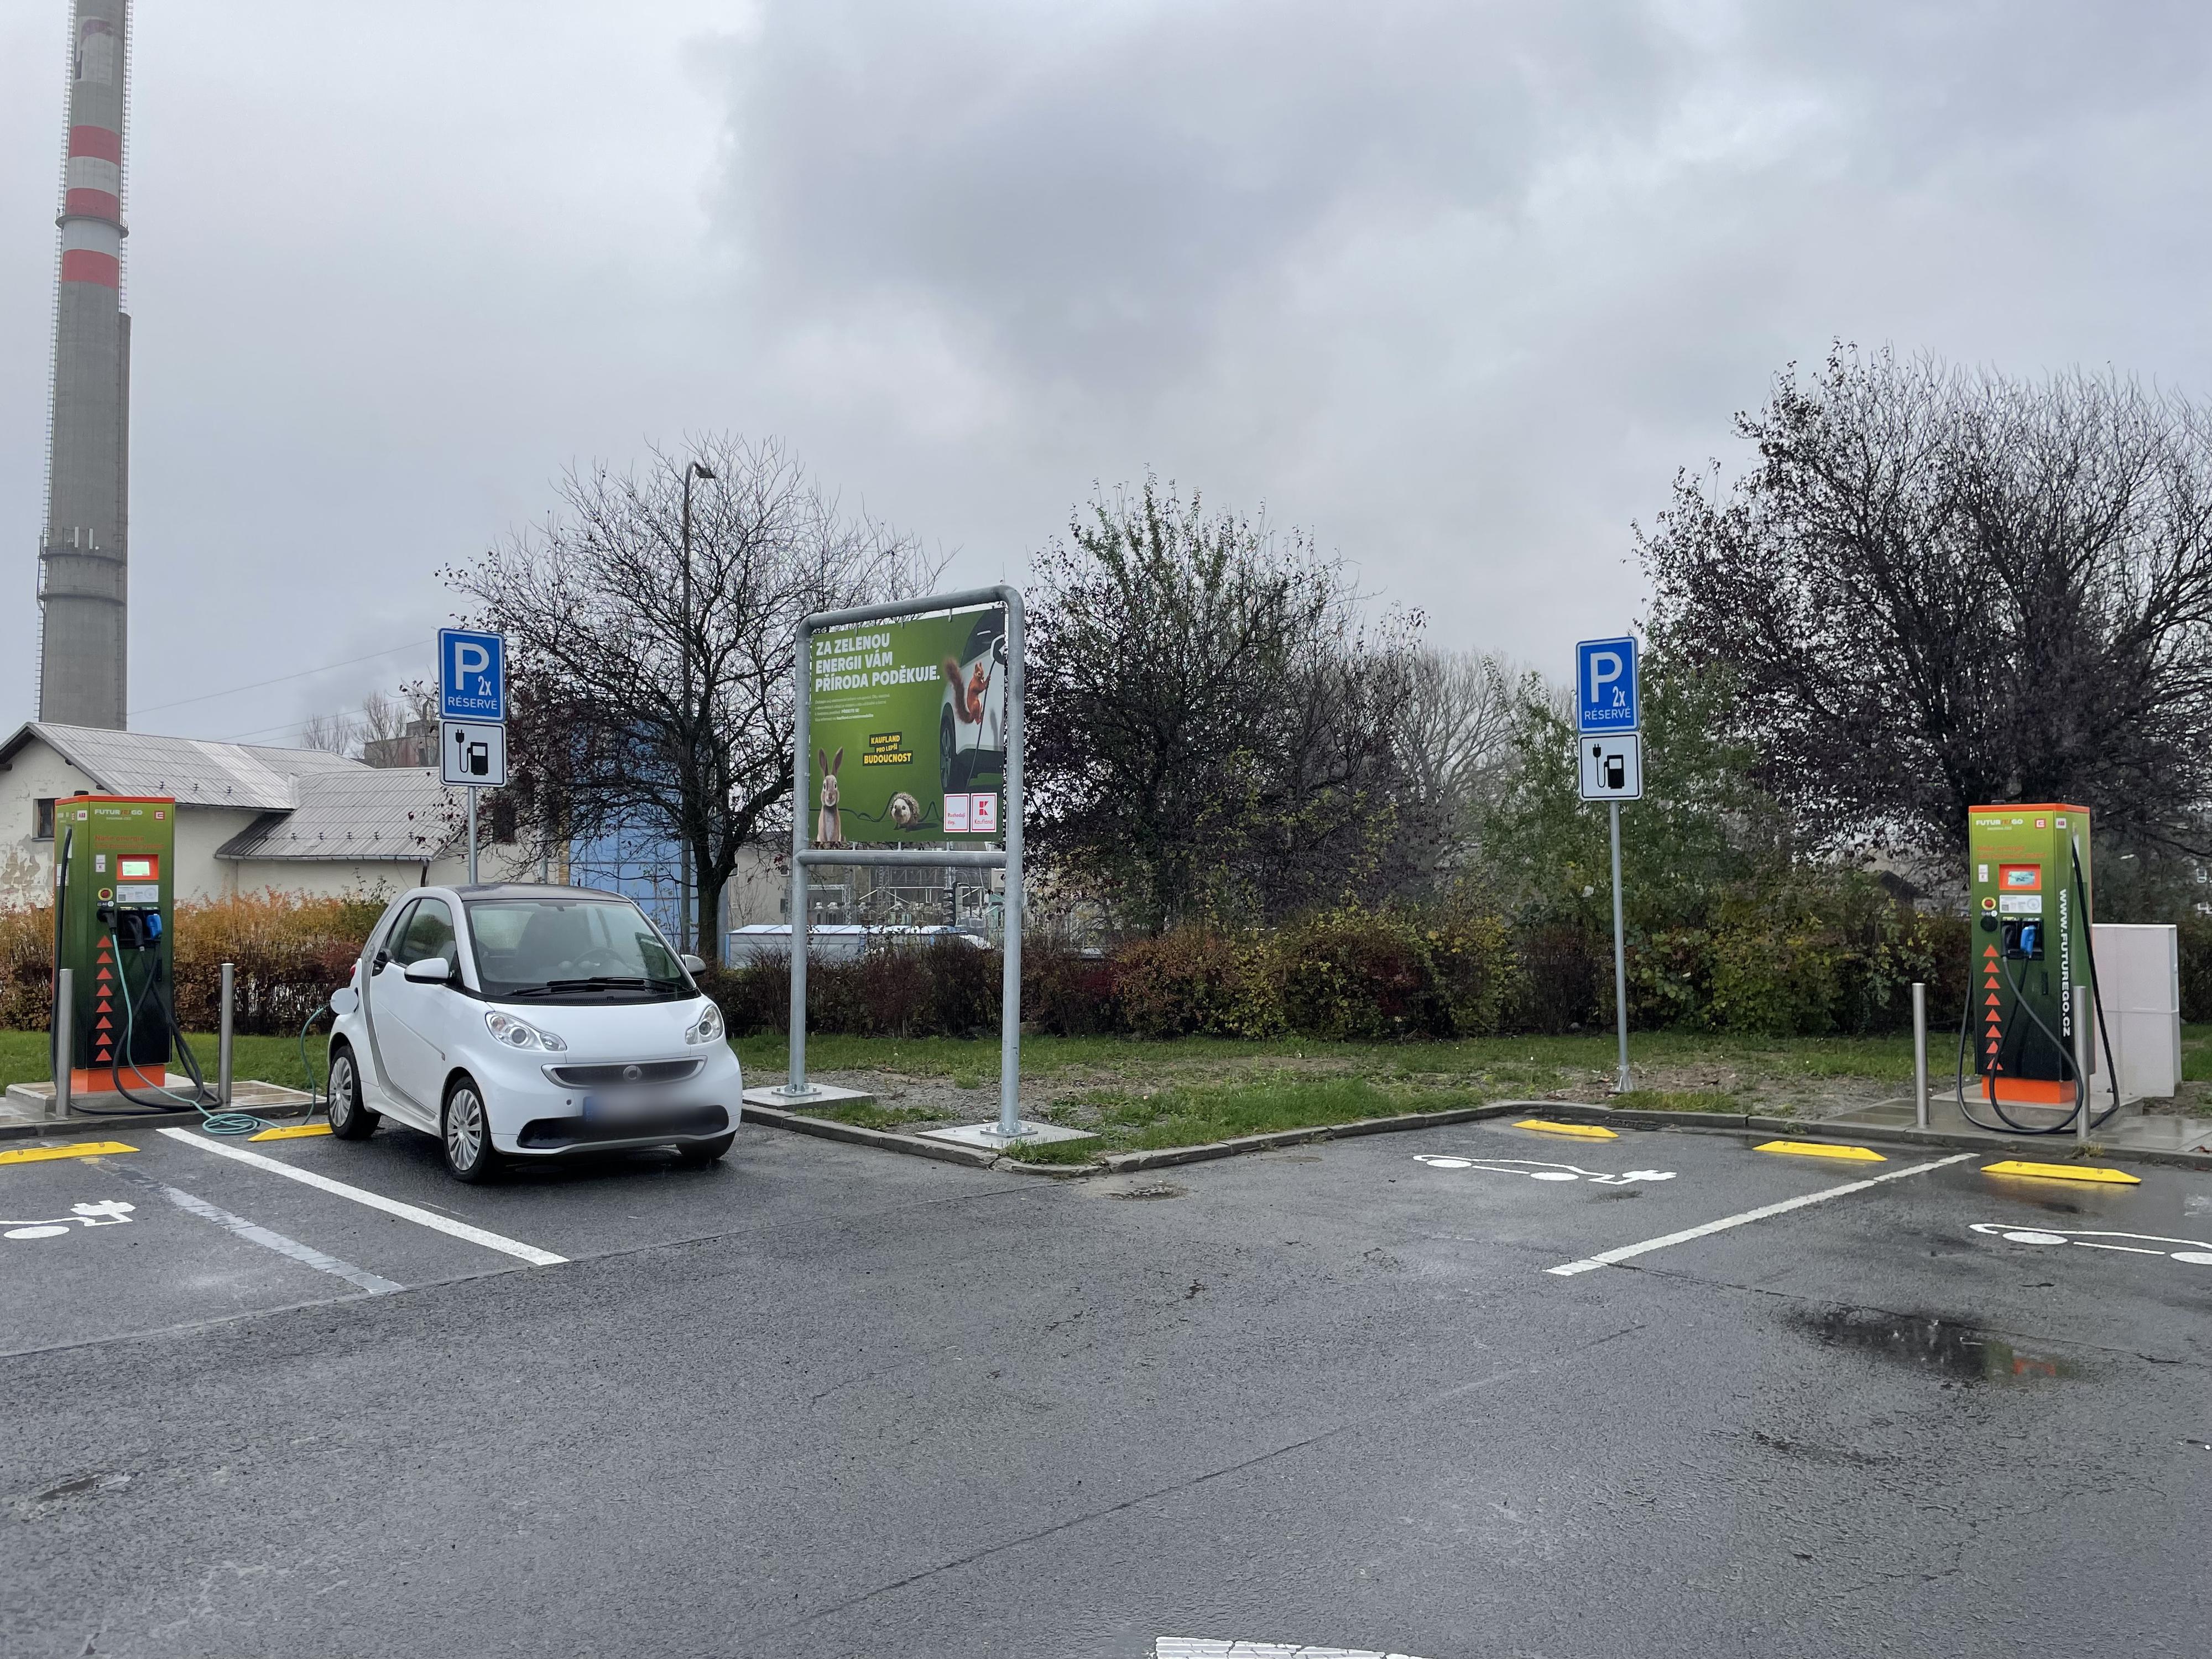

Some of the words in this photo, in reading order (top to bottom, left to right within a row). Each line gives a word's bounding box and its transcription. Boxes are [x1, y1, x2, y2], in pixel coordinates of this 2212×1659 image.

[816, 641, 832, 656] ZA
[834, 633, 890, 654] ZELENOU
[455, 641, 489, 691] P
[816, 655, 862, 674] ENERGII
[865, 649, 893, 668] VÁM
[478, 675, 492, 696] 2x
[815, 673, 869, 692] PŘÍRODA
[872, 665, 940, 686] PODĚKUJE.
[1590, 651, 1623, 703] P
[448, 695, 498, 710] RÉSERVÉ
[1613, 686, 1626, 707] 2x
[1584, 706, 1631, 721] RÉSERVÉ
[870, 735, 900, 744] KAUFLAND
[886, 743, 898, 752] LEPŠÍ
[864, 753, 912, 764] BUDOUCNOST
[2059, 889, 2070, 1037] WWW.FUTUREGO.CZ
